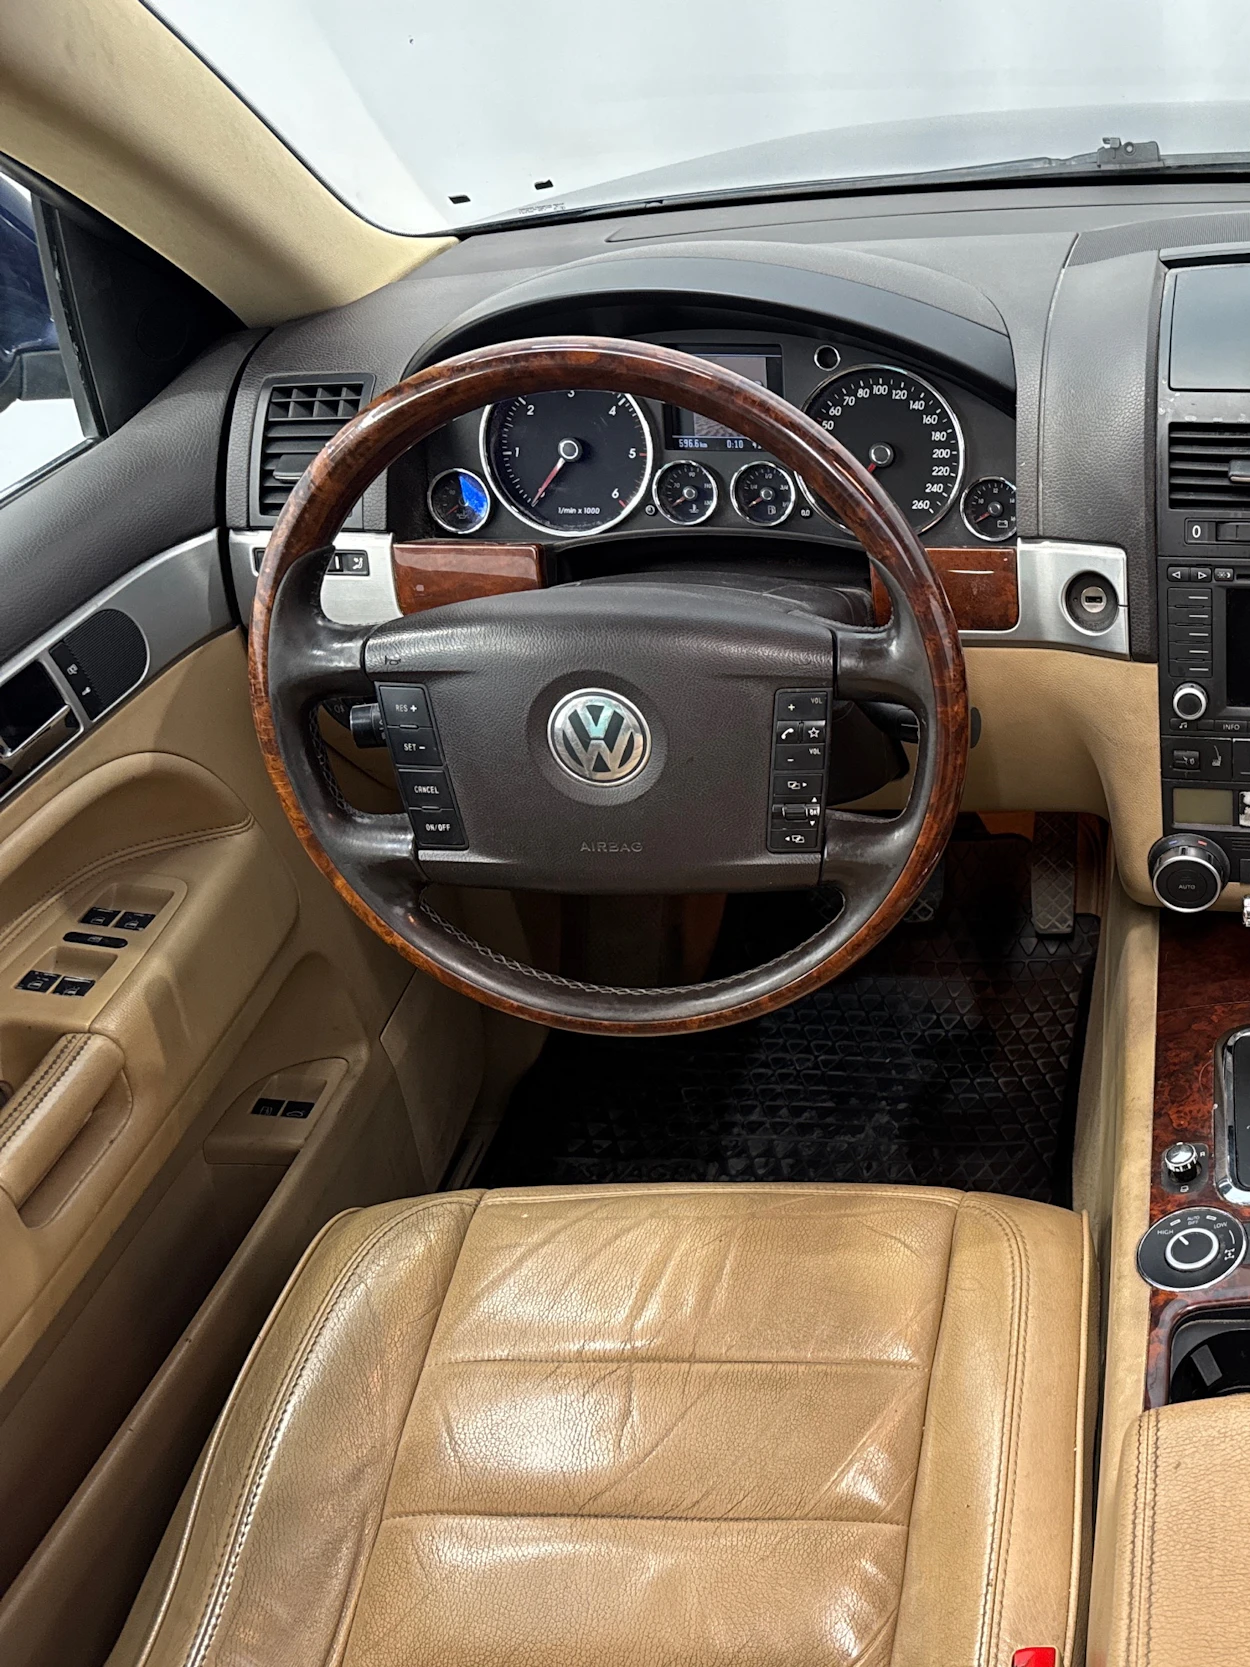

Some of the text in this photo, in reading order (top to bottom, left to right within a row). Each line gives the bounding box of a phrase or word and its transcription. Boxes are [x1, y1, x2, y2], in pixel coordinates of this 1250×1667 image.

[857, 386, 870, 398] 80
[872, 384, 889, 395] 100
[891, 388, 908, 400] 120
[843, 396, 855, 407] 70
[909, 400, 925, 411] 140
[527, 404, 535, 416] 2
[608, 405, 616, 416] 4
[829, 405, 842, 416] 60
[822, 420, 834, 430] 50
[922, 414, 938, 425] 160
[931, 430, 947, 442] 180
[726, 440, 744, 449] 0:10
[514, 447, 520, 458] 1
[628, 448, 636, 459] 5
[932, 448, 950, 459] 200
[932, 465, 950, 477] 220
[611, 488, 619, 499] 6
[925, 483, 944, 494] 240
[557, 506, 577, 515] 1/min
[583, 507, 600, 515] 1000
[912, 500, 930, 511] 260
[1192, 525, 1201, 539] 0
[395, 704, 409, 713] RES
[403, 743, 417, 751] SET
[809, 747, 821, 755] VOL
[413, 785, 440, 795] CANCEL
[424, 822, 451, 832] ON/OFF
[579, 841, 643, 853] AIRBAG
